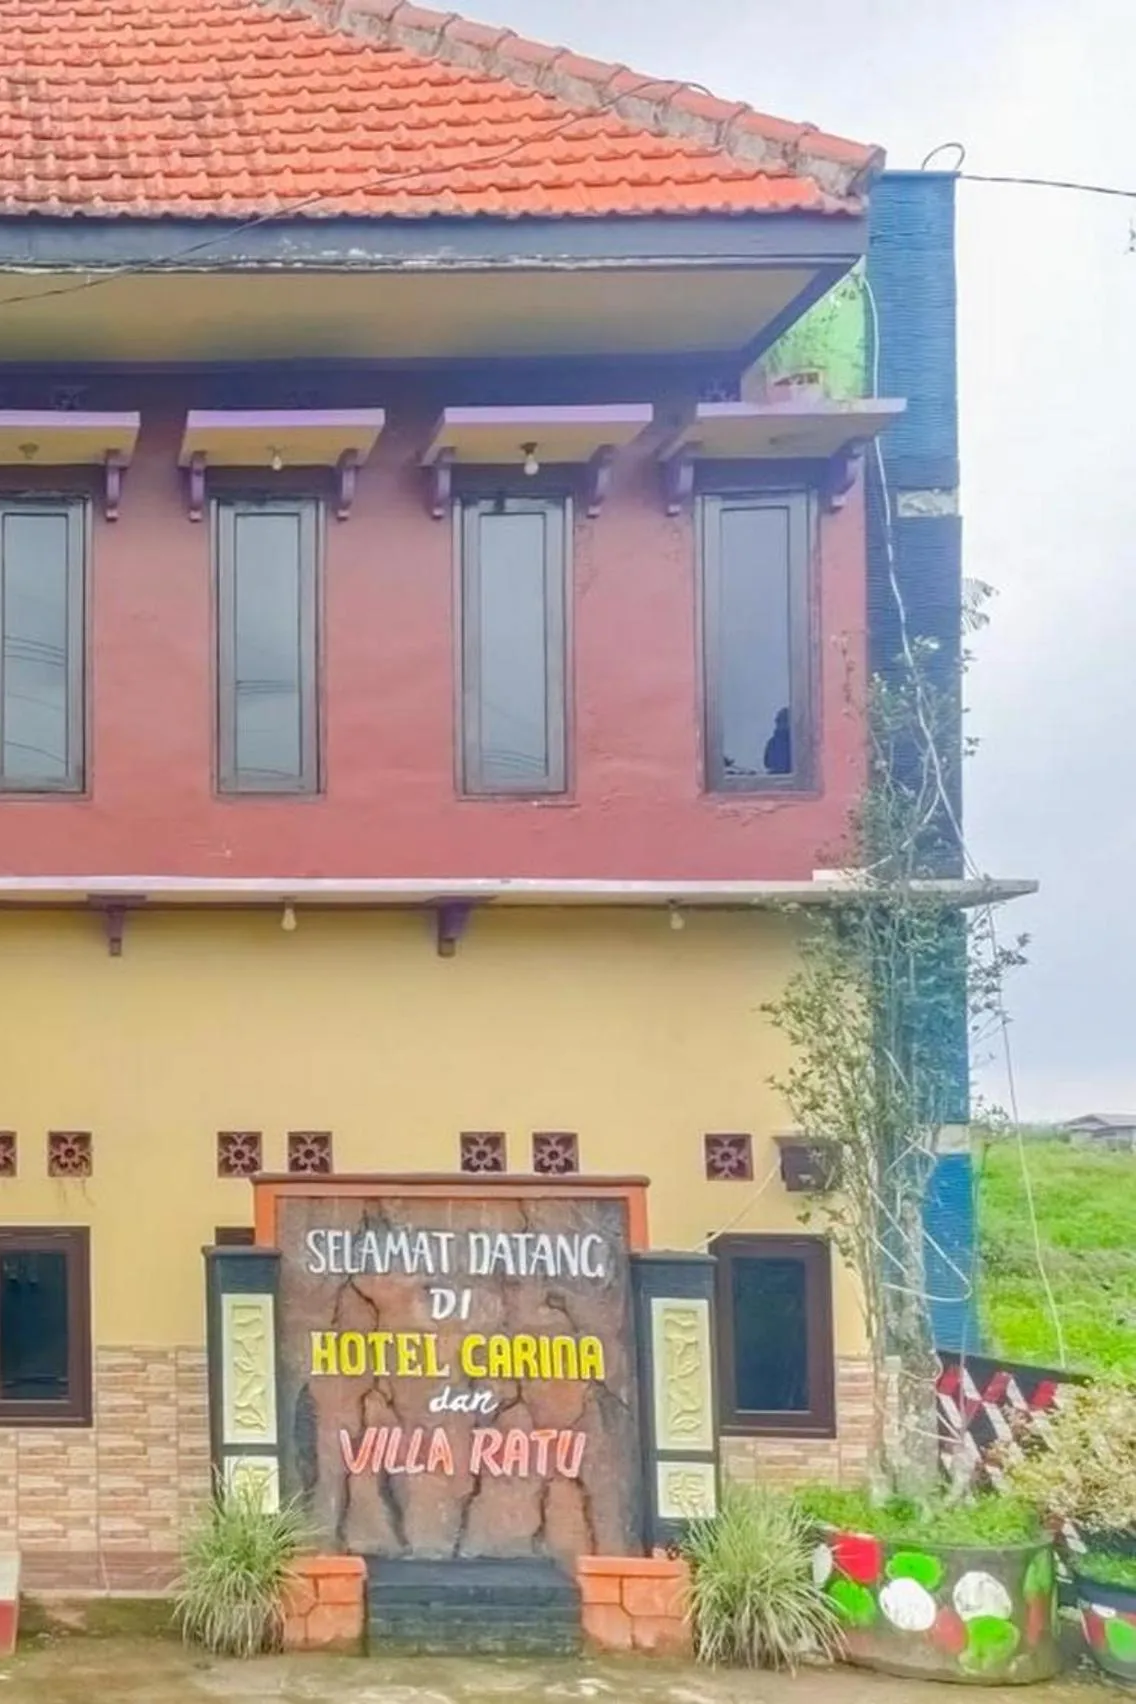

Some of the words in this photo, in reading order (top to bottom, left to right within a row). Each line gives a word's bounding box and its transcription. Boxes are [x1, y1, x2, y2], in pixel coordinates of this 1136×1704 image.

[306, 1229, 455, 1276] SELAMAT
[469, 1231, 606, 1278] DATANG
[430, 1288, 472, 1320] DI
[309, 1331, 450, 1379] HOTEL
[461, 1334, 606, 1381] CARINA
[428, 1386, 499, 1414] dan
[339, 1427, 453, 1476] VILLA
[470, 1428, 587, 1479] RATU
